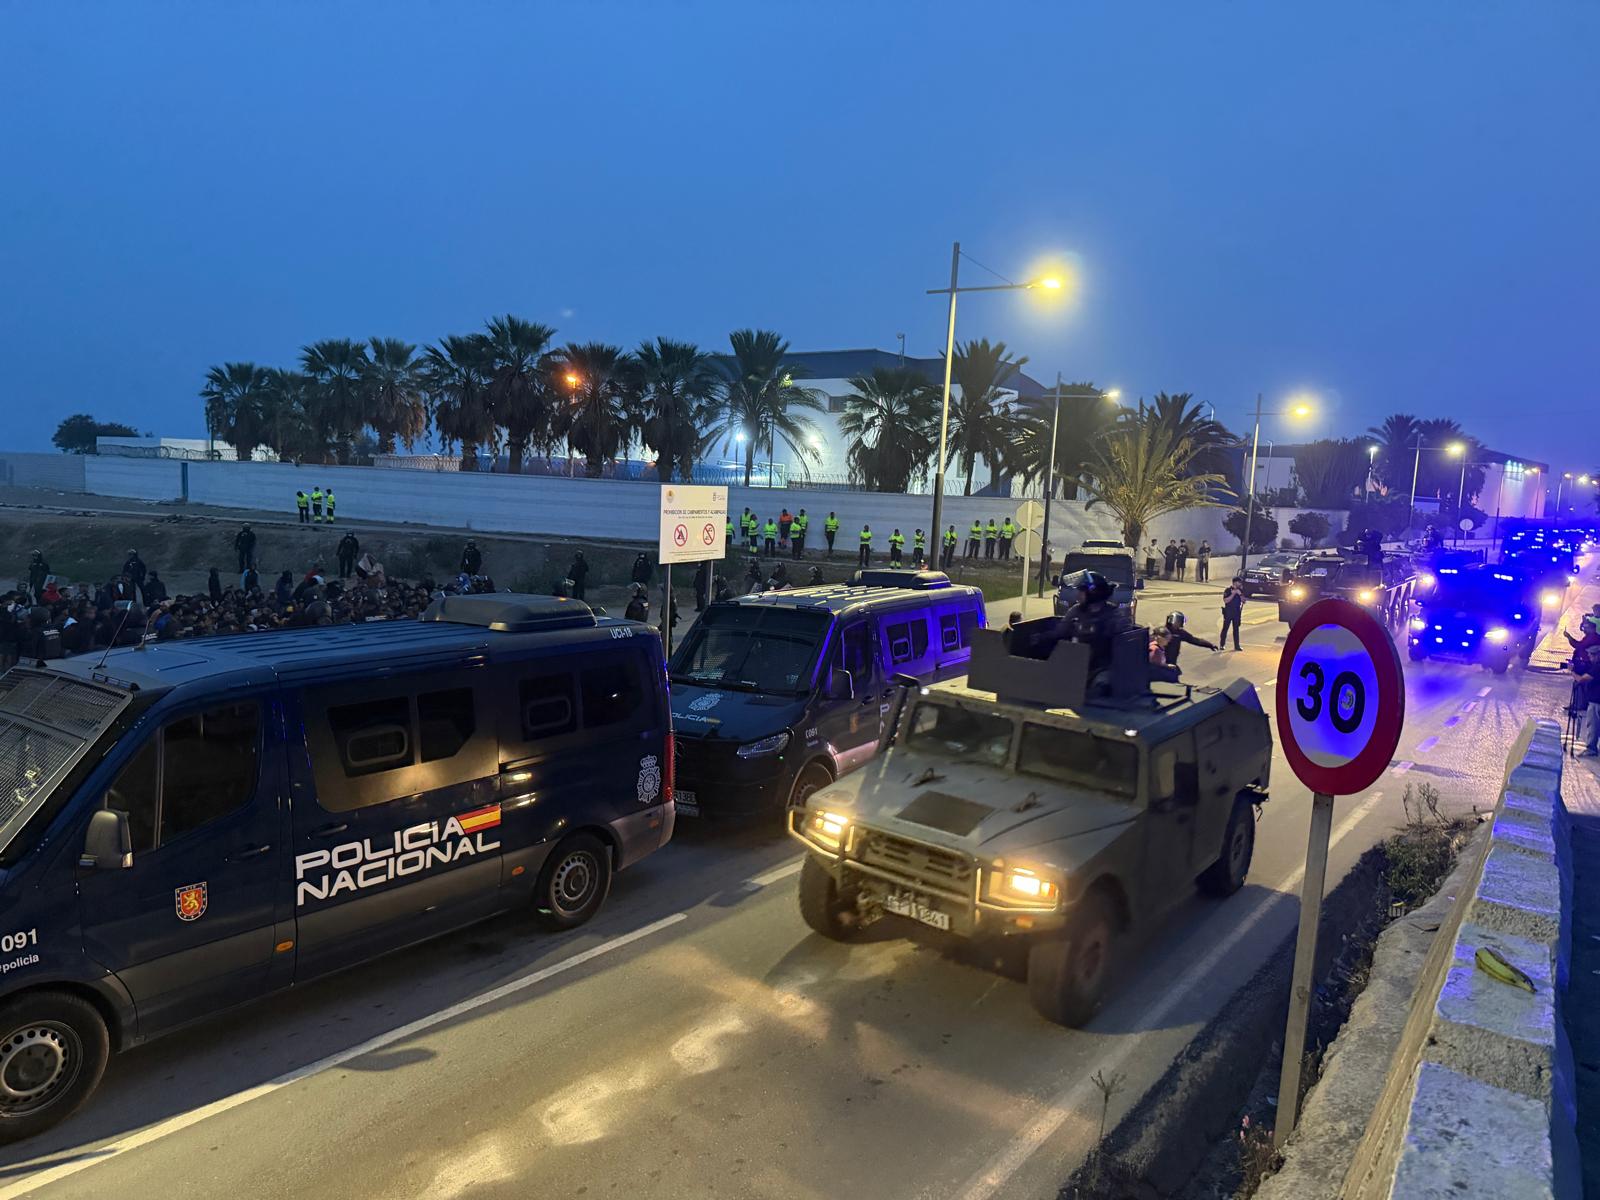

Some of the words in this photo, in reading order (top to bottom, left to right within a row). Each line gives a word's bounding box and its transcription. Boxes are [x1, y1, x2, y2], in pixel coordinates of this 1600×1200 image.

[1296, 661, 1365, 734] 30
[297, 832, 501, 906] NACIONAL
[0, 954, 39, 973] policia
[1, 928, 37, 952] 091
